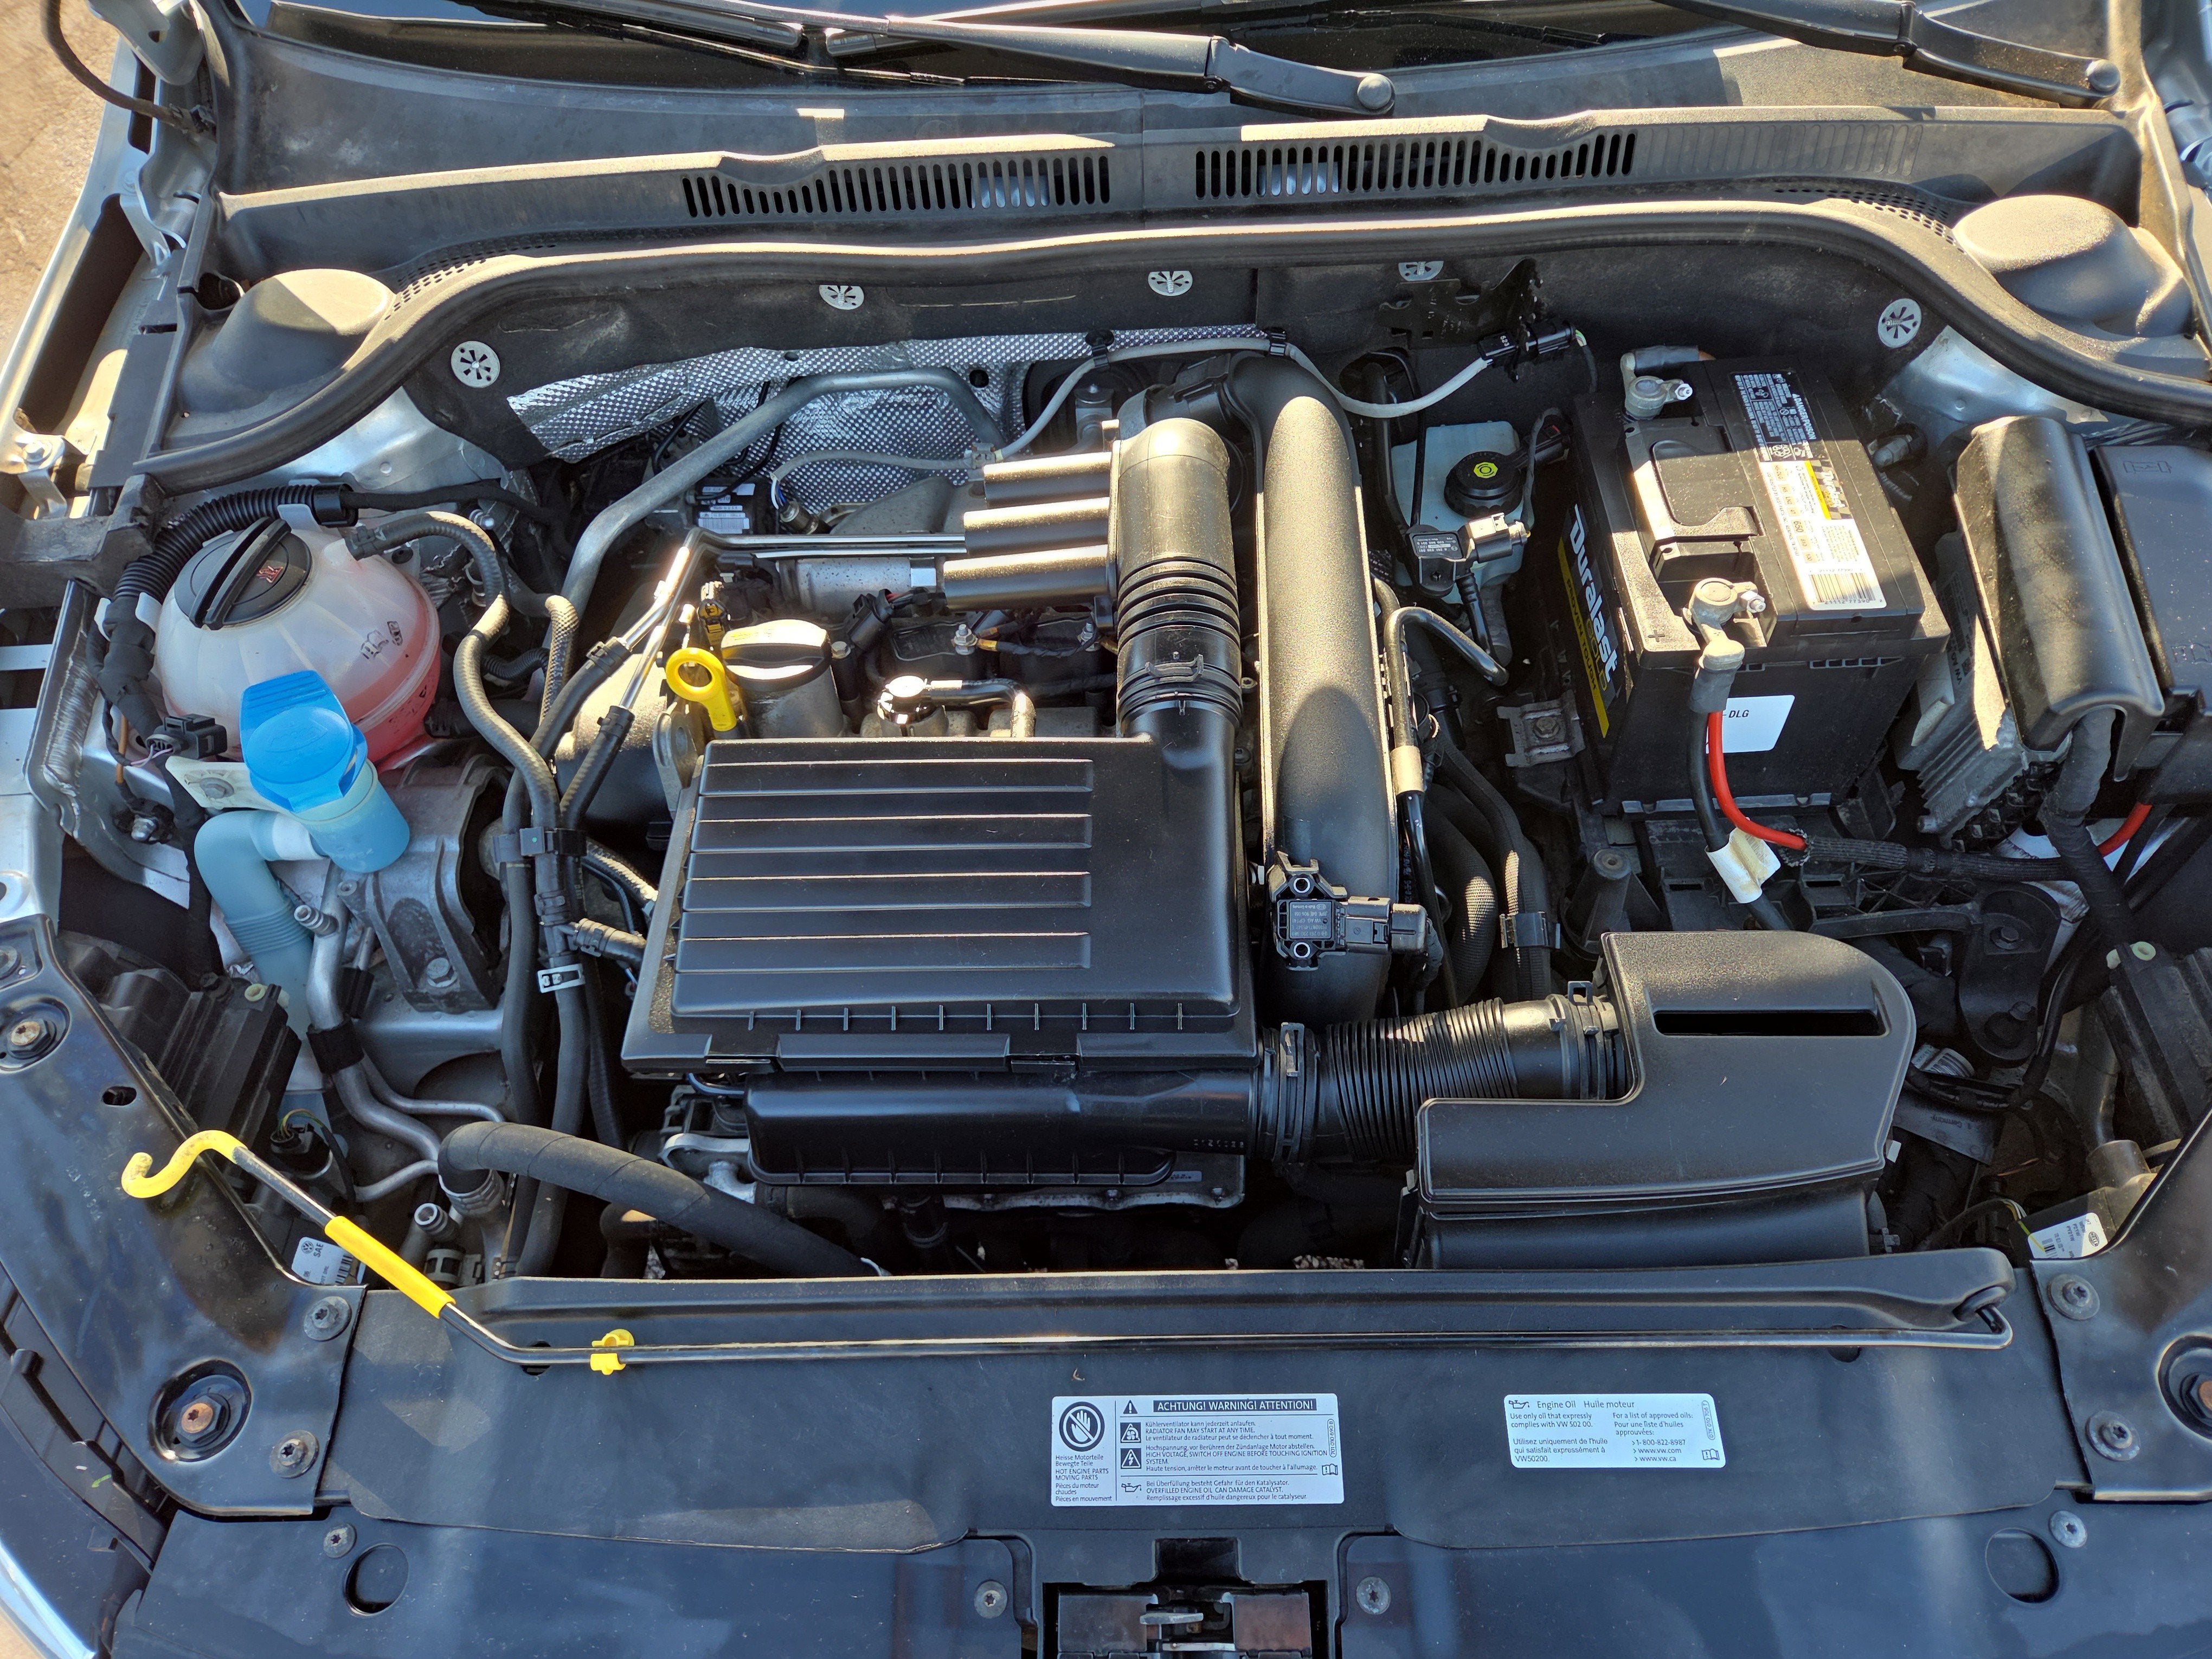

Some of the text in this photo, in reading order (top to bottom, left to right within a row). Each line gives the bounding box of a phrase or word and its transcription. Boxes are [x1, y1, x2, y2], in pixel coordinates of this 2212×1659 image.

[1820, 470, 1846, 509] Duralast
[1792, 520, 1804, 533] 650
[1570, 503, 1617, 683] Duralast
[1566, 578, 1597, 690] PROVEN TOUGH
[1586, 618, 1607, 691] GOLD
[313, 1242, 324, 1258] SAE
[1158, 1400, 1313, 1411] ACHTUNG! WARNING! ATTENTION!
[1537, 1401, 1564, 1410] Engine
[1584, 1400, 1604, 1408] Huile
[1649, 1412, 1679, 1420] approved
[1616, 1427, 1654, 1437] approuvées:
